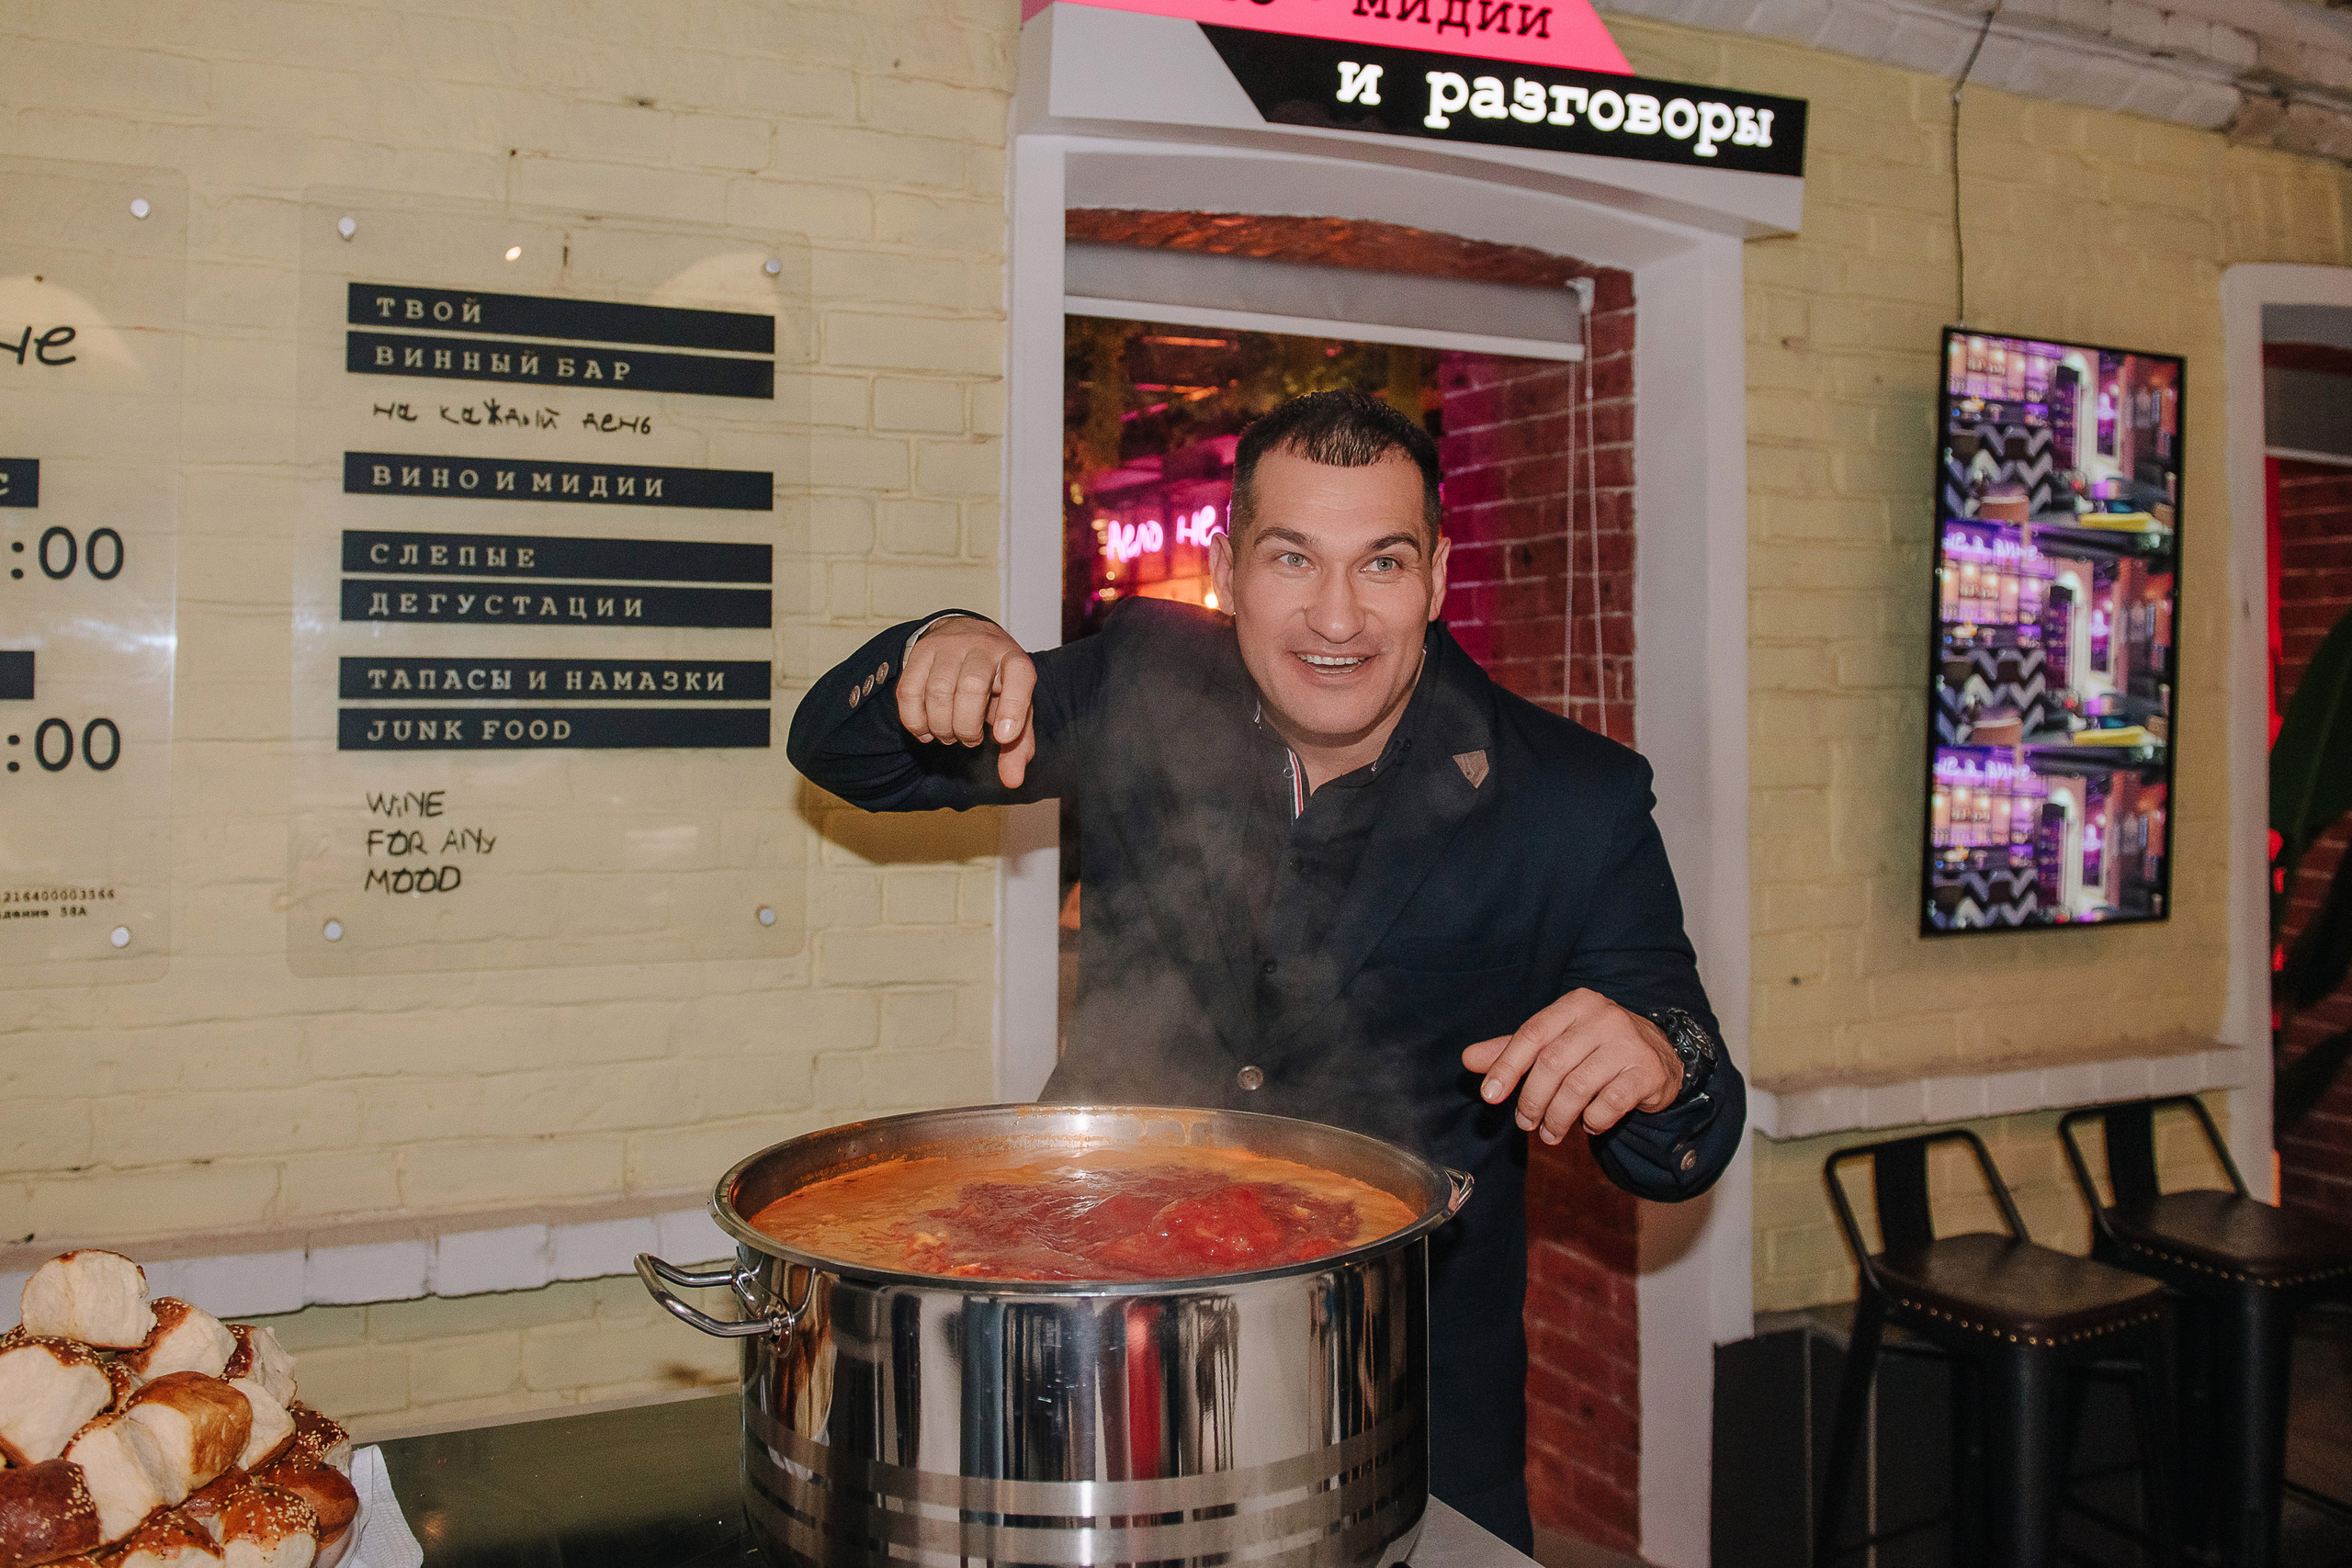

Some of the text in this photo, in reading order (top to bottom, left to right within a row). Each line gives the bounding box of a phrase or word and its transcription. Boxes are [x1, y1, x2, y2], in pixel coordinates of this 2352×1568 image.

[1336, 61, 1775, 156] и разговоры
[376, 297, 482, 325] ТВОЙ
[374, 344, 631, 381] ВИННЫЙ БАР
[373, 402, 418, 423] на
[582, 412, 651, 435] день
[372, 465, 664, 498] ВИНО И МИДИИ
[369, 544, 536, 569] СЛЕПЫЕ
[368, 592, 644, 620] ДЕГУСТАЦИИ
[368, 669, 726, 692] ТАПАСЫ И НАМАЗКИ
[367, 719, 571, 741] JUNK FOOD
[366, 829, 428, 857] FOR
[365, 865, 461, 895] MOOD
